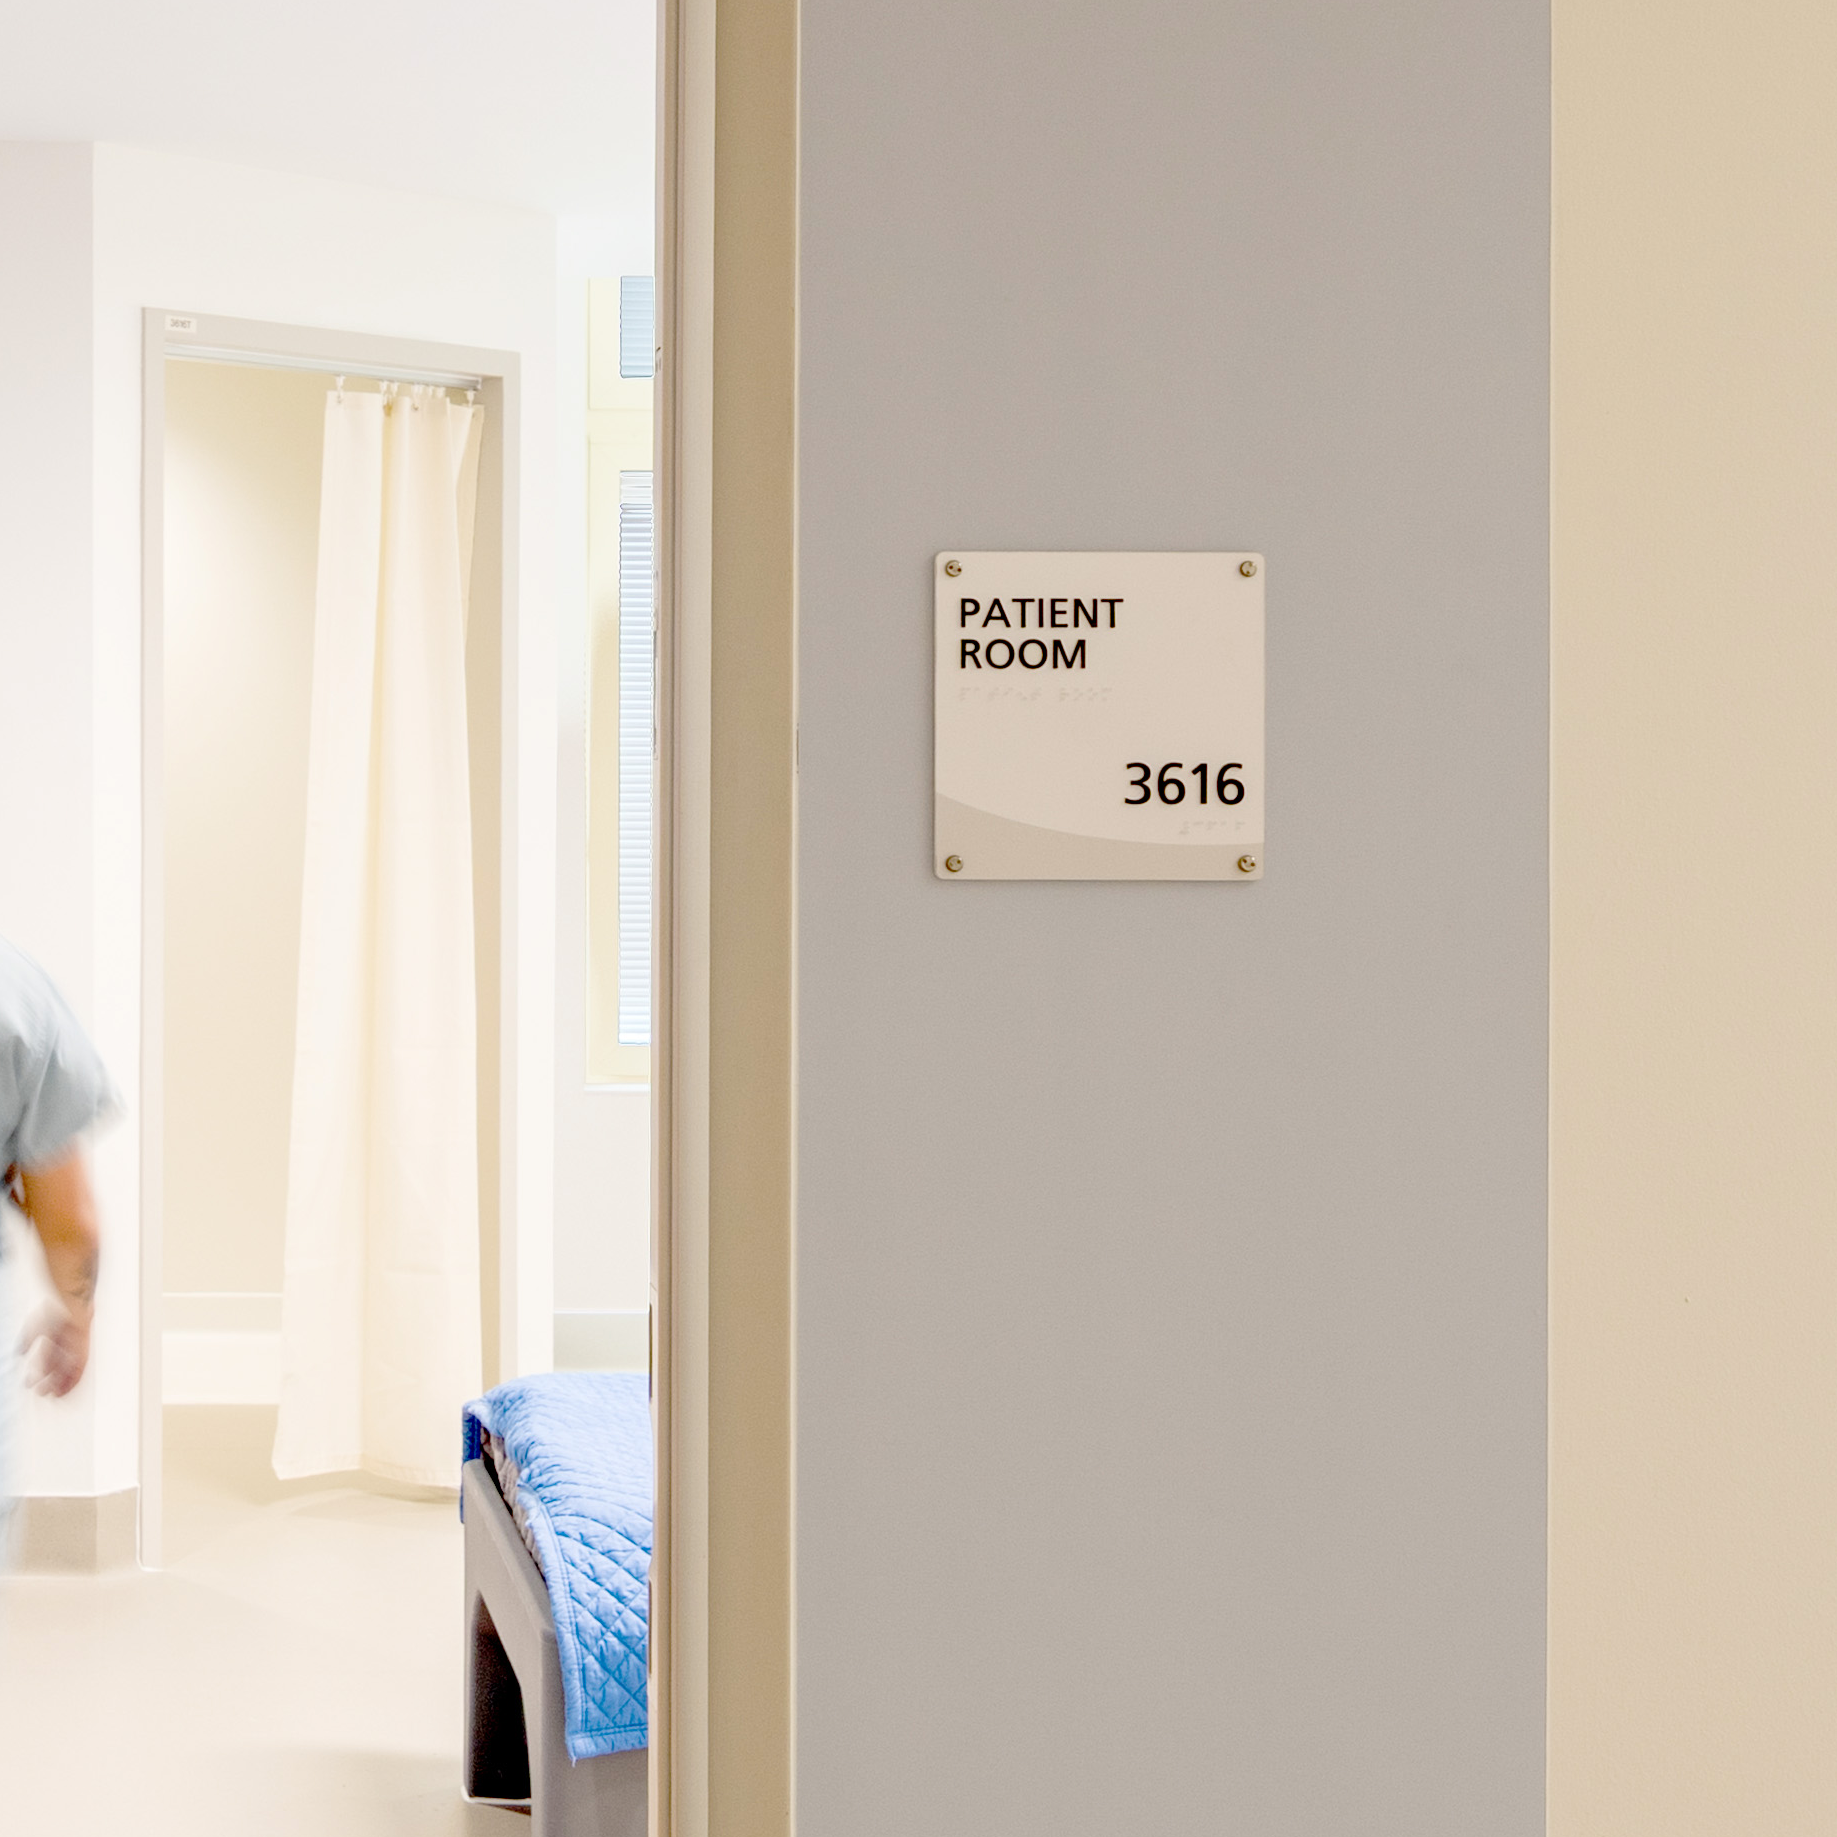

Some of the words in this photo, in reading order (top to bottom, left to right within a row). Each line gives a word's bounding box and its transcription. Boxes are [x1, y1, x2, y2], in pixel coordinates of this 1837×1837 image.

[960, 598, 1124, 628] PATIENT
[960, 638, 1087, 669] ROOM
[1124, 762, 1245, 806] 3616
